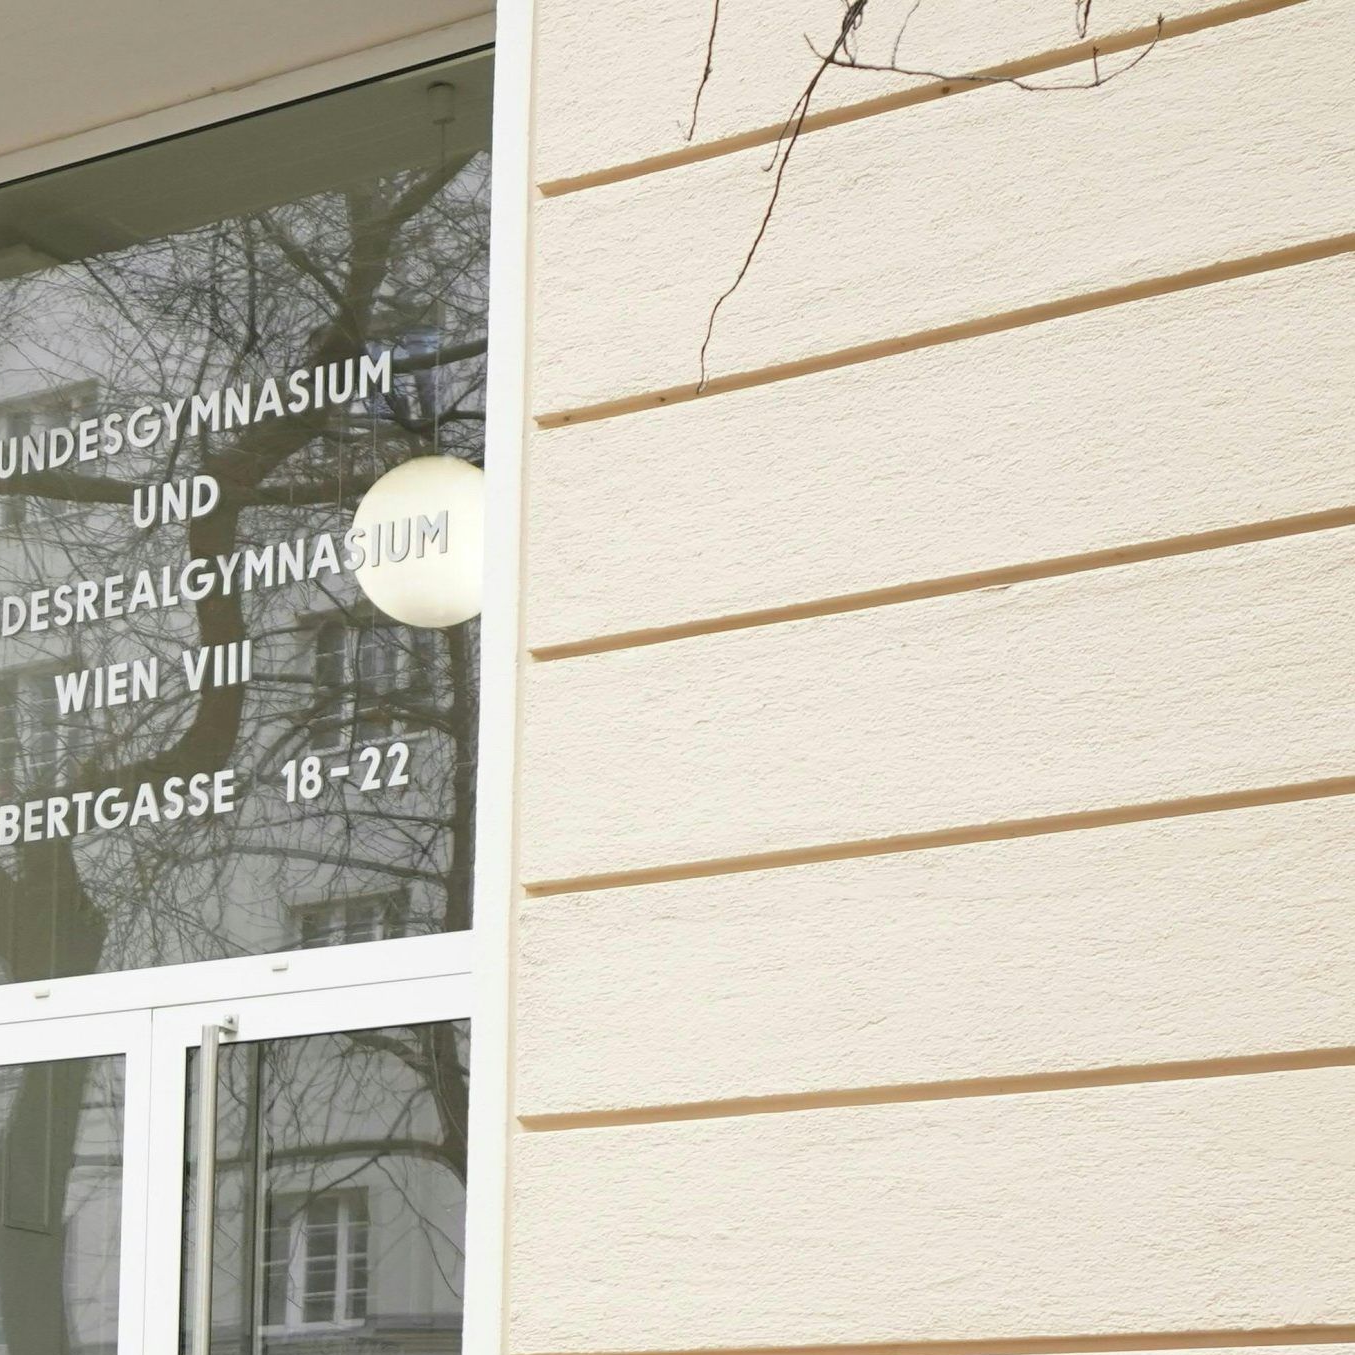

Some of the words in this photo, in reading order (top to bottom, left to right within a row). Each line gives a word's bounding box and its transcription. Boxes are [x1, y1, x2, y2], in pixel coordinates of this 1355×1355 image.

[133, 475, 219, 528] UND
[55, 658, 158, 714] WIEN
[182, 640, 252, 692] VIII
